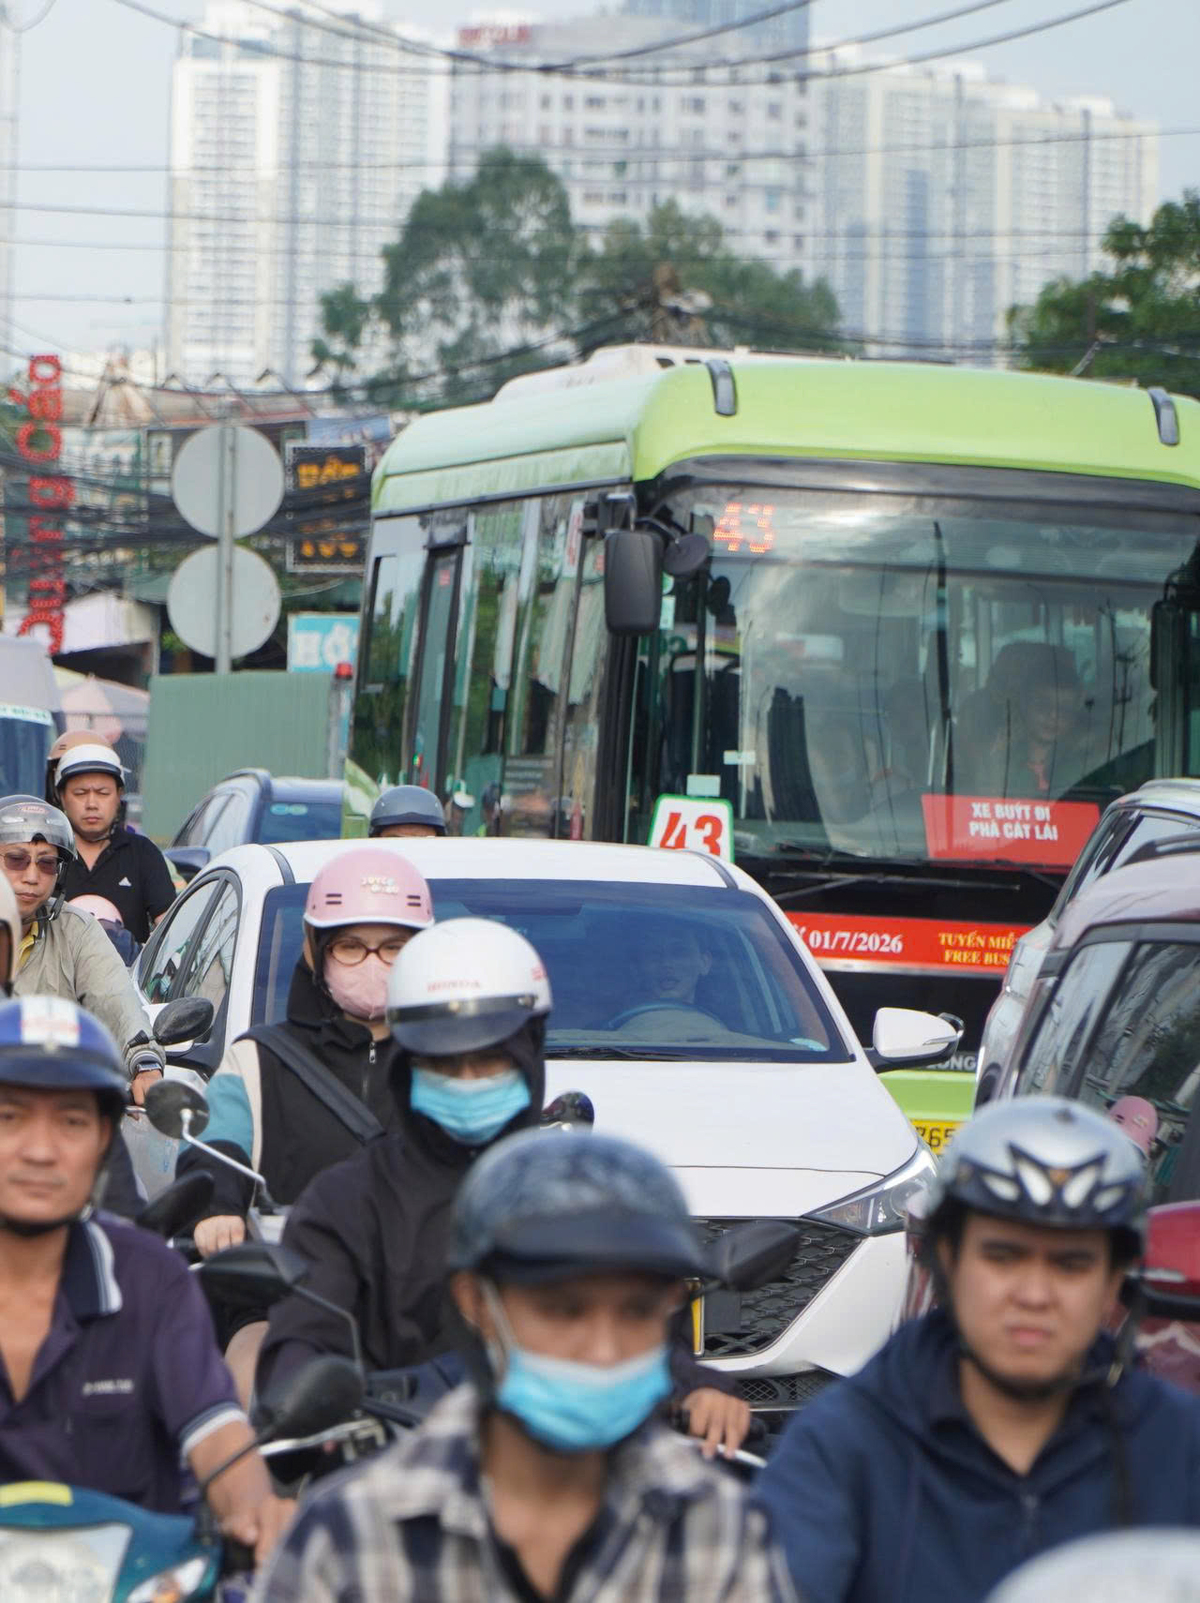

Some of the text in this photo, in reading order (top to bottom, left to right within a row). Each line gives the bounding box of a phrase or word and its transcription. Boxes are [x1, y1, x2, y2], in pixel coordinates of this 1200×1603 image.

[8, 355, 62, 464] Cáo
[712, 502, 775, 553] 43
[972, 802, 991, 818] XE
[994, 801, 1031, 820] BUÝT
[660, 812, 723, 856] 43
[809, 930, 903, 953] 01/7/2026
[944, 949, 1010, 966] FREE BUS
